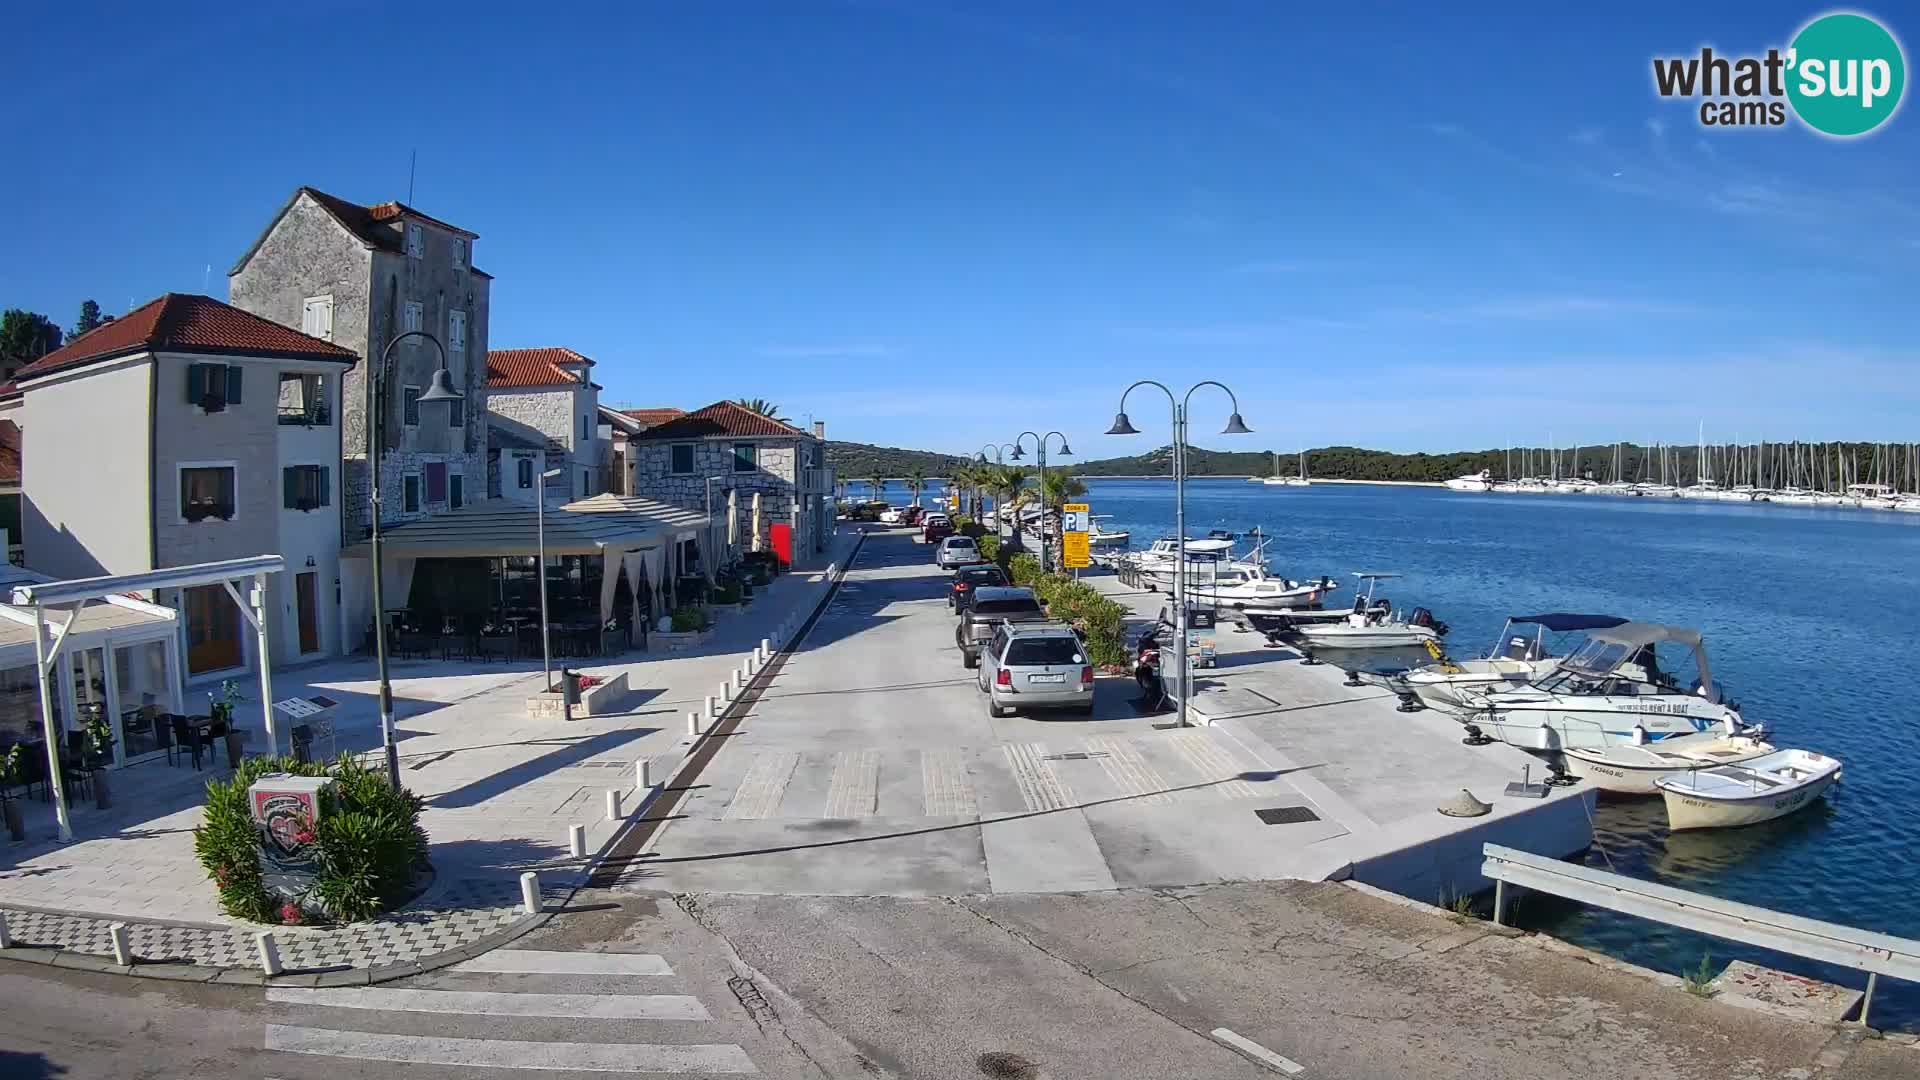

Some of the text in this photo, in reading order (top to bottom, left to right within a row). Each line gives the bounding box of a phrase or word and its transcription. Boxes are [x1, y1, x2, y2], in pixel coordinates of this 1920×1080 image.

[1065, 513, 1076, 530] P
[1649, 703, 1666, 713] RENT
[1673, 704, 1688, 714] BOAT
